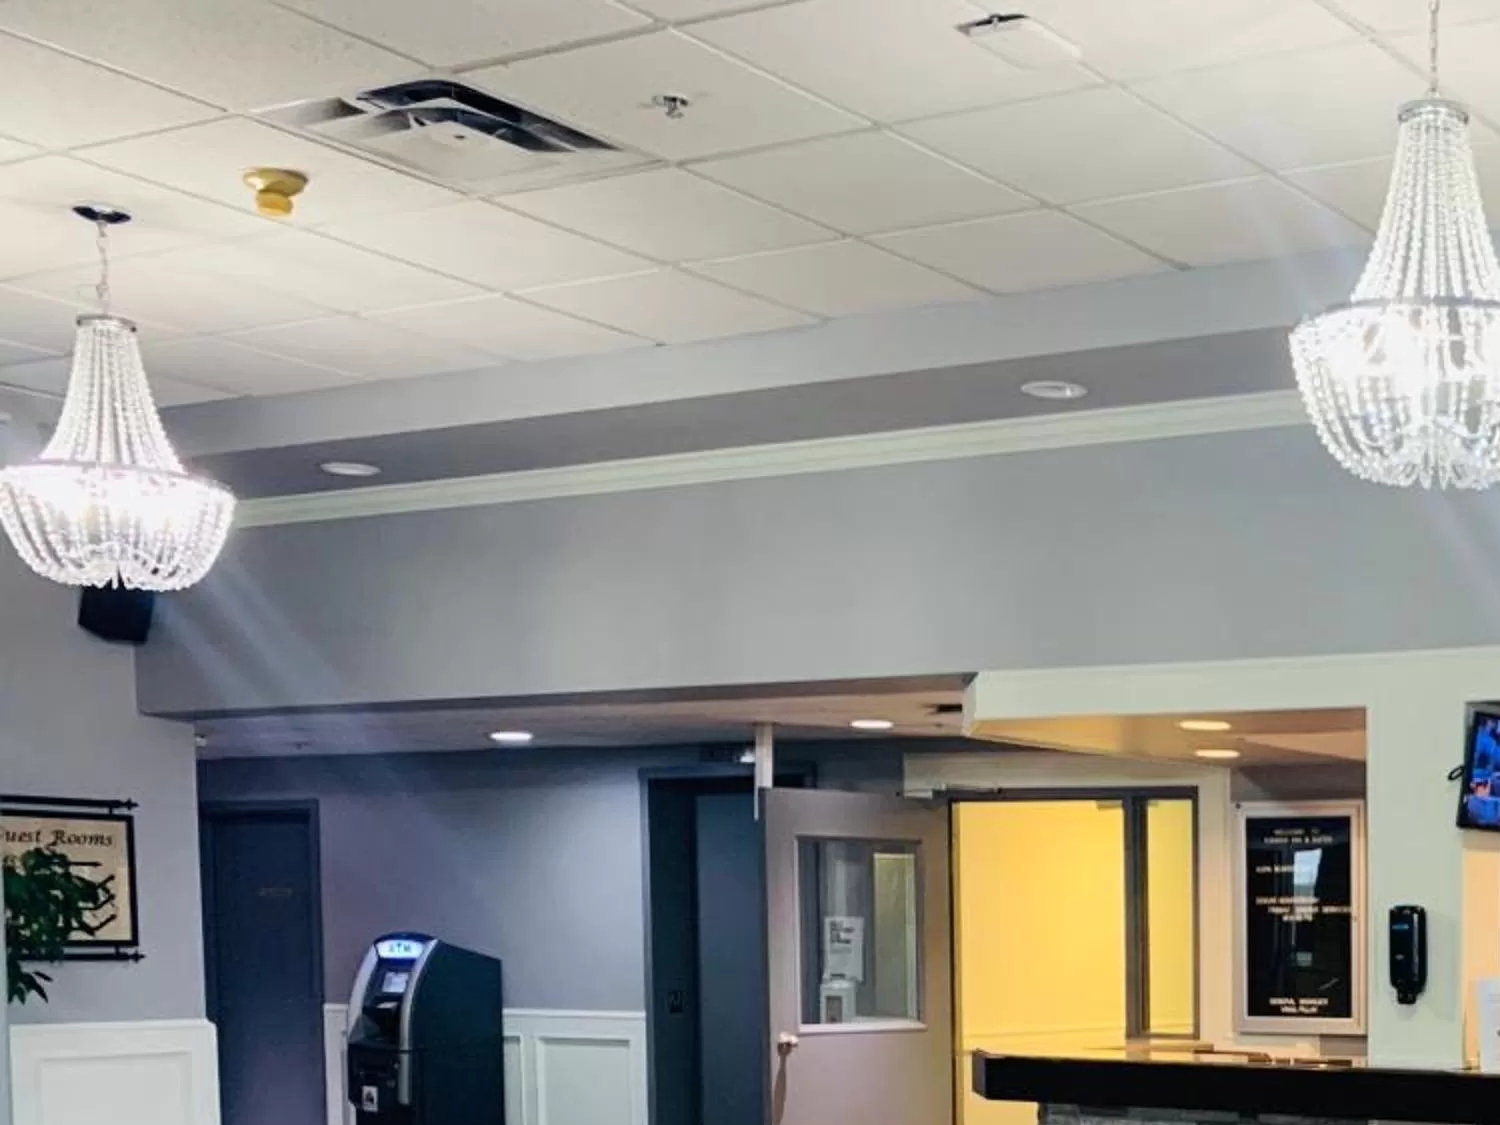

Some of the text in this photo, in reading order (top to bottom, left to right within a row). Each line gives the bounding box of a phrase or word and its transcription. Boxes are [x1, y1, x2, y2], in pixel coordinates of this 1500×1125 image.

[0, 829, 113, 849] uest Rooms
[388, 942, 412, 953] ATM
